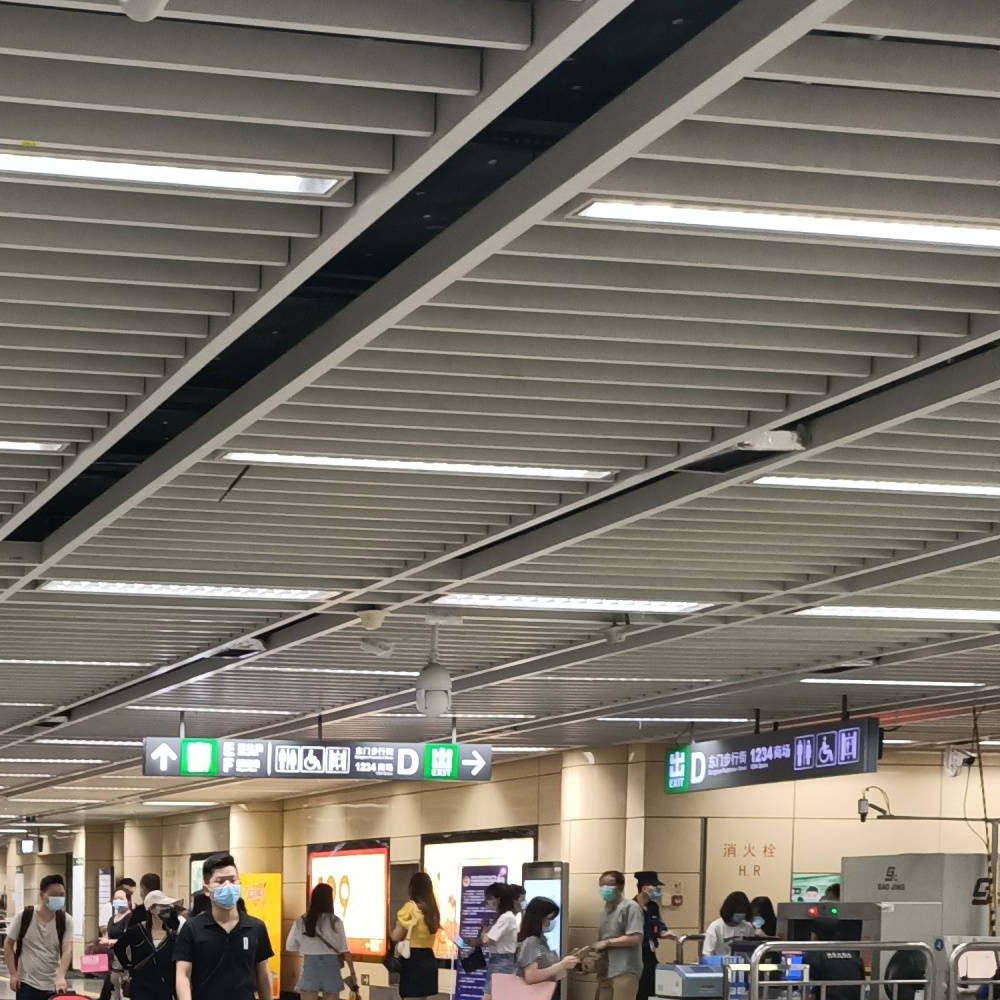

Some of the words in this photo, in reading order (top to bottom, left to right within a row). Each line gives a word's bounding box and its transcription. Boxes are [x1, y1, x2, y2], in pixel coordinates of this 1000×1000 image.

[397, 748, 419, 775] D
[669, 751, 685, 778] 出
[690, 751, 706, 784] D
[722, 842, 776, 858] 消火栓
